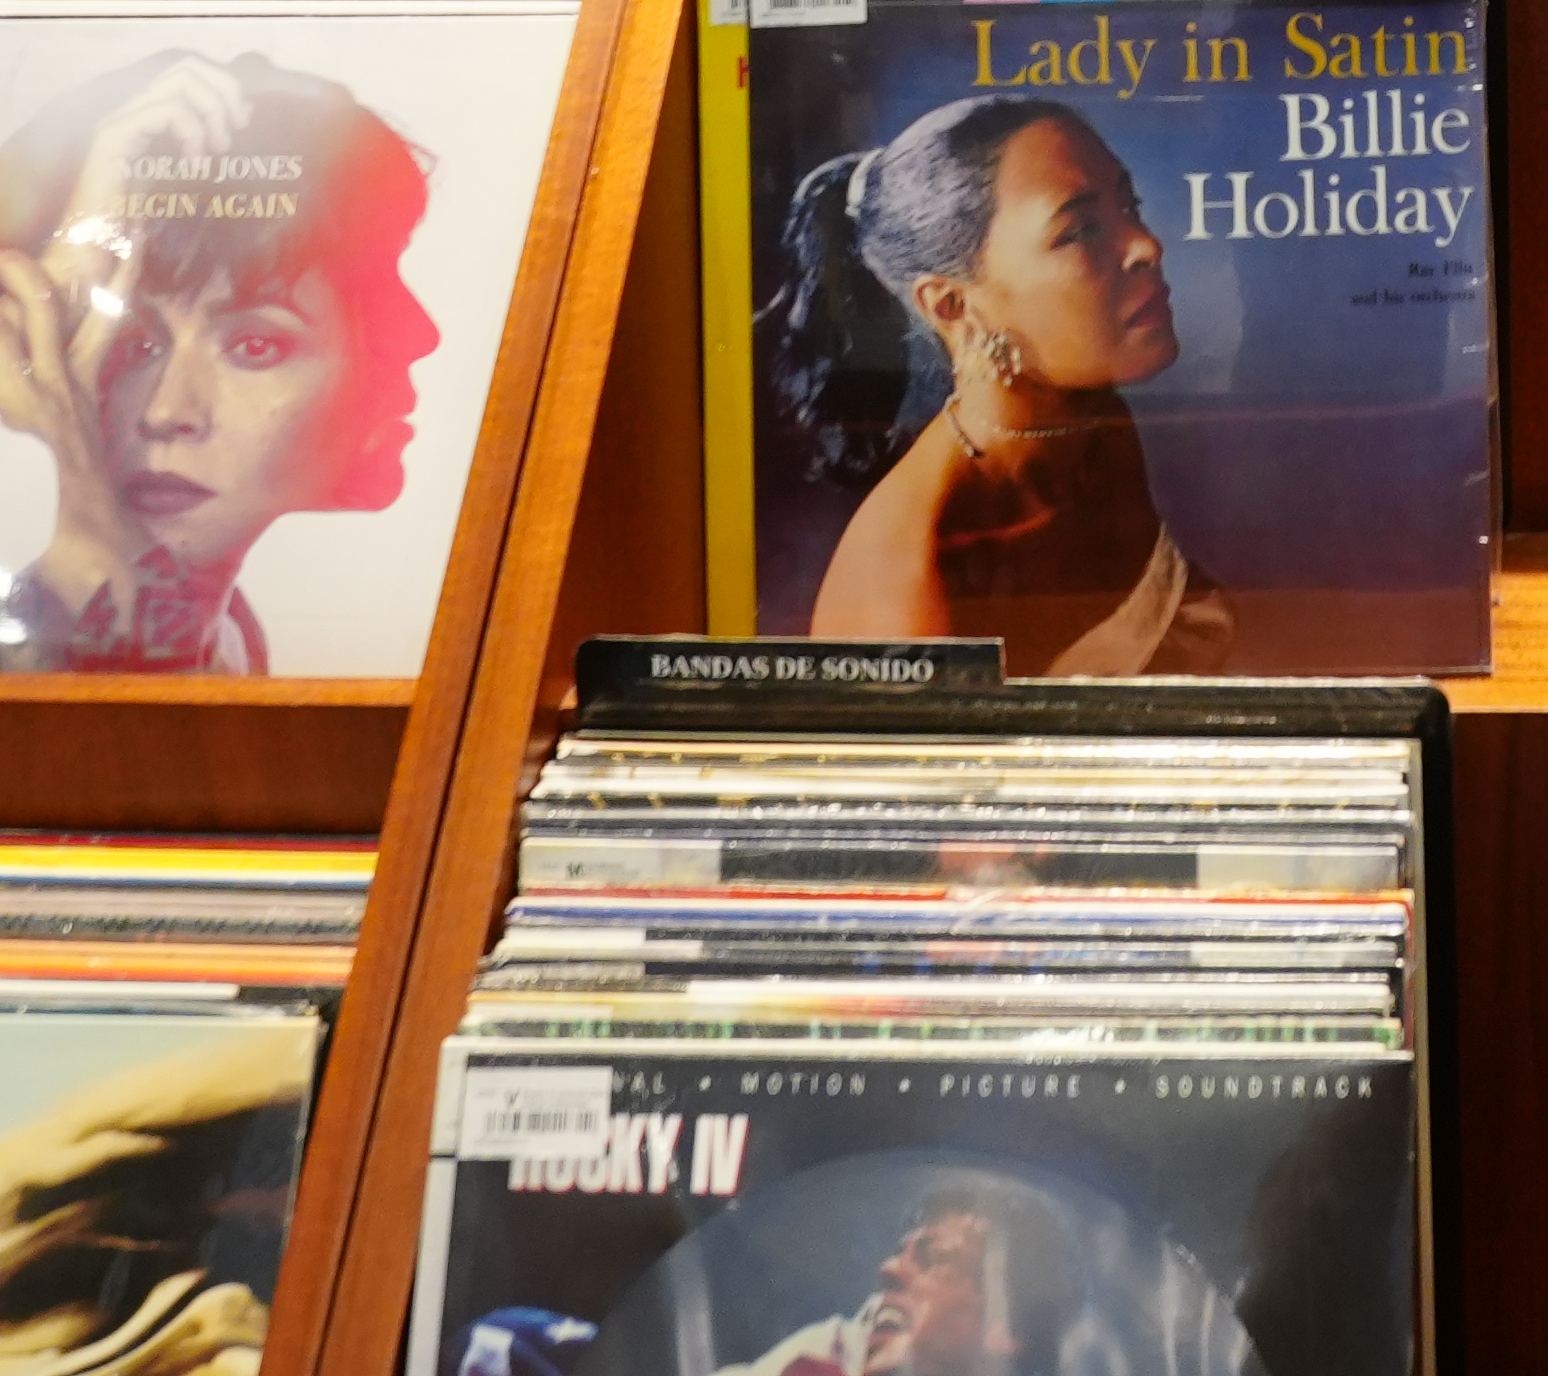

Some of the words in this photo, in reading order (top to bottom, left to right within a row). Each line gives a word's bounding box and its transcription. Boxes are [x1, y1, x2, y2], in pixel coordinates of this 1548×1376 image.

[971, 15, 1158, 100] Lady
[1184, 22, 1253, 83] in
[1284, 12, 1470, 81] Satin
[1279, 90, 1472, 162] Billie
[118, 155, 211, 183] NORAH
[215, 154, 303, 181] JONES
[109, 192, 198, 220] BEGIN
[206, 191, 299, 220] AGAIN
[1183, 167, 1474, 246] Holiday
[650, 653, 771, 681] BANDAS
[776, 656, 808, 680] DE
[814, 656, 934, 684] SONIDO
[739, 1073, 865, 1097] MOTION
[940, 1074, 1082, 1099] PICTURE
[1156, 1076, 1374, 1101] SOUNDTRACK
[691, 1113, 748, 1195] IV
